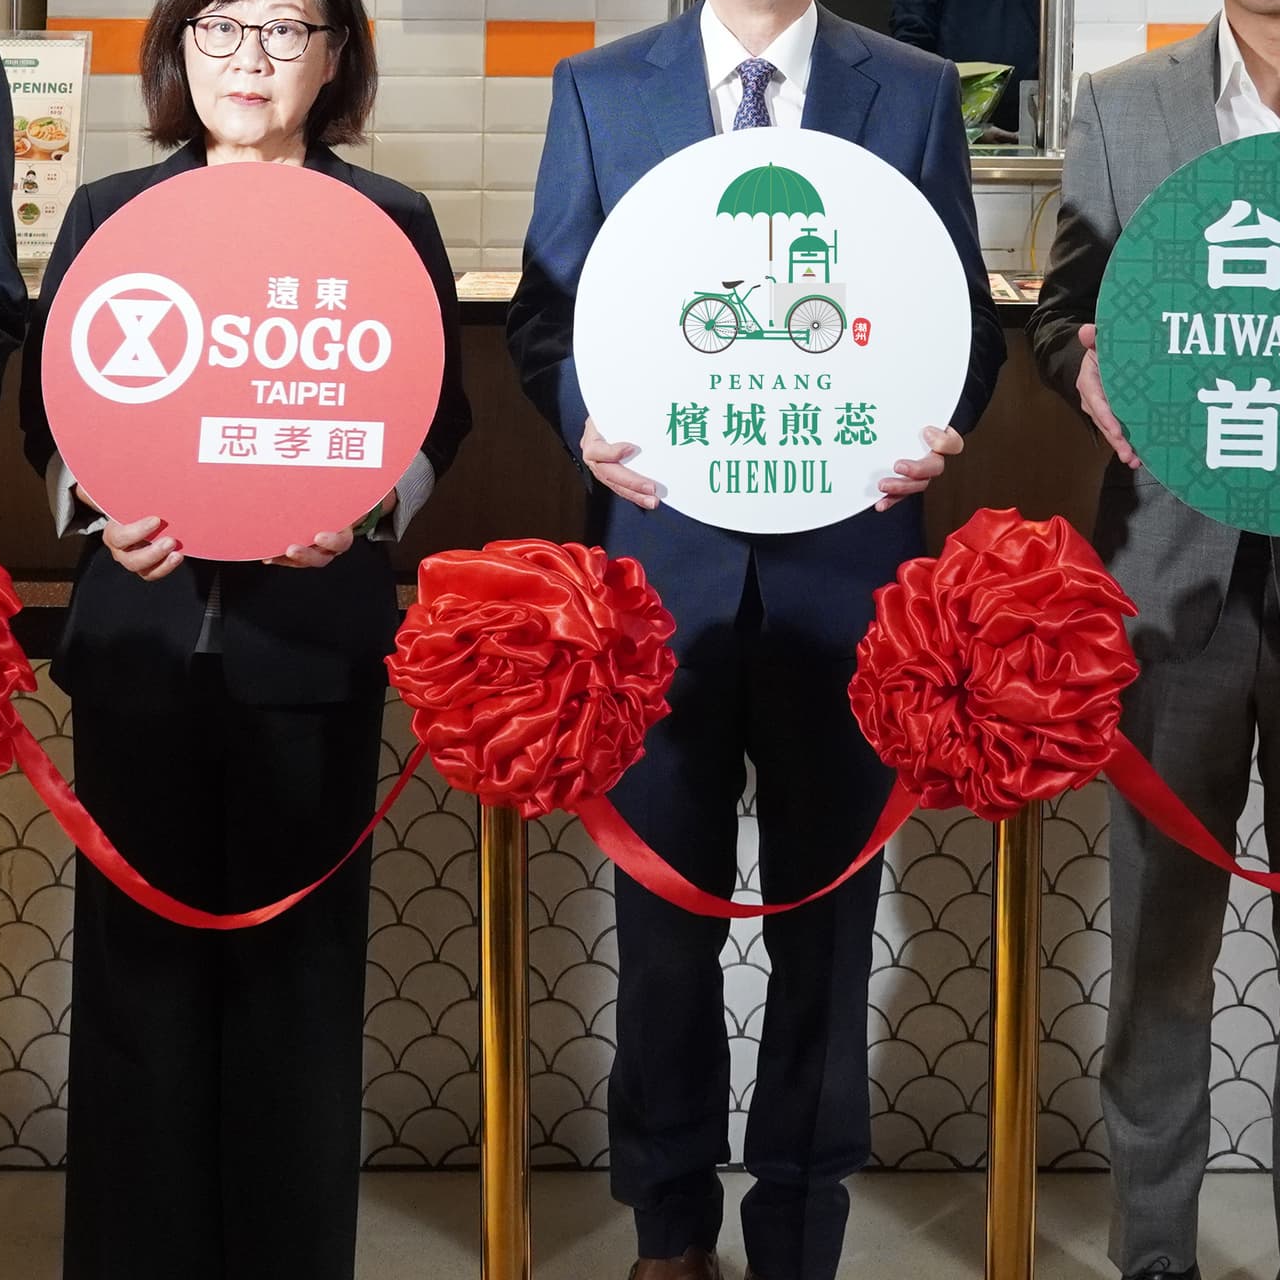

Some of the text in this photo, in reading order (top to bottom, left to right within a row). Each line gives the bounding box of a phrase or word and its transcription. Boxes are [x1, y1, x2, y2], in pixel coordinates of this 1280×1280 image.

[266, 276, 349, 311] 遠東
[208, 314, 392, 372] SOGO
[853, 321, 868, 342] 潮州
[251, 379, 345, 406] TAIPEI
[709, 373, 832, 391] PENANG
[666, 402, 878, 447] 檳城煎蕊
[218, 424, 367, 461] 忠孝館
[709, 460, 832, 494] CHENDUL
